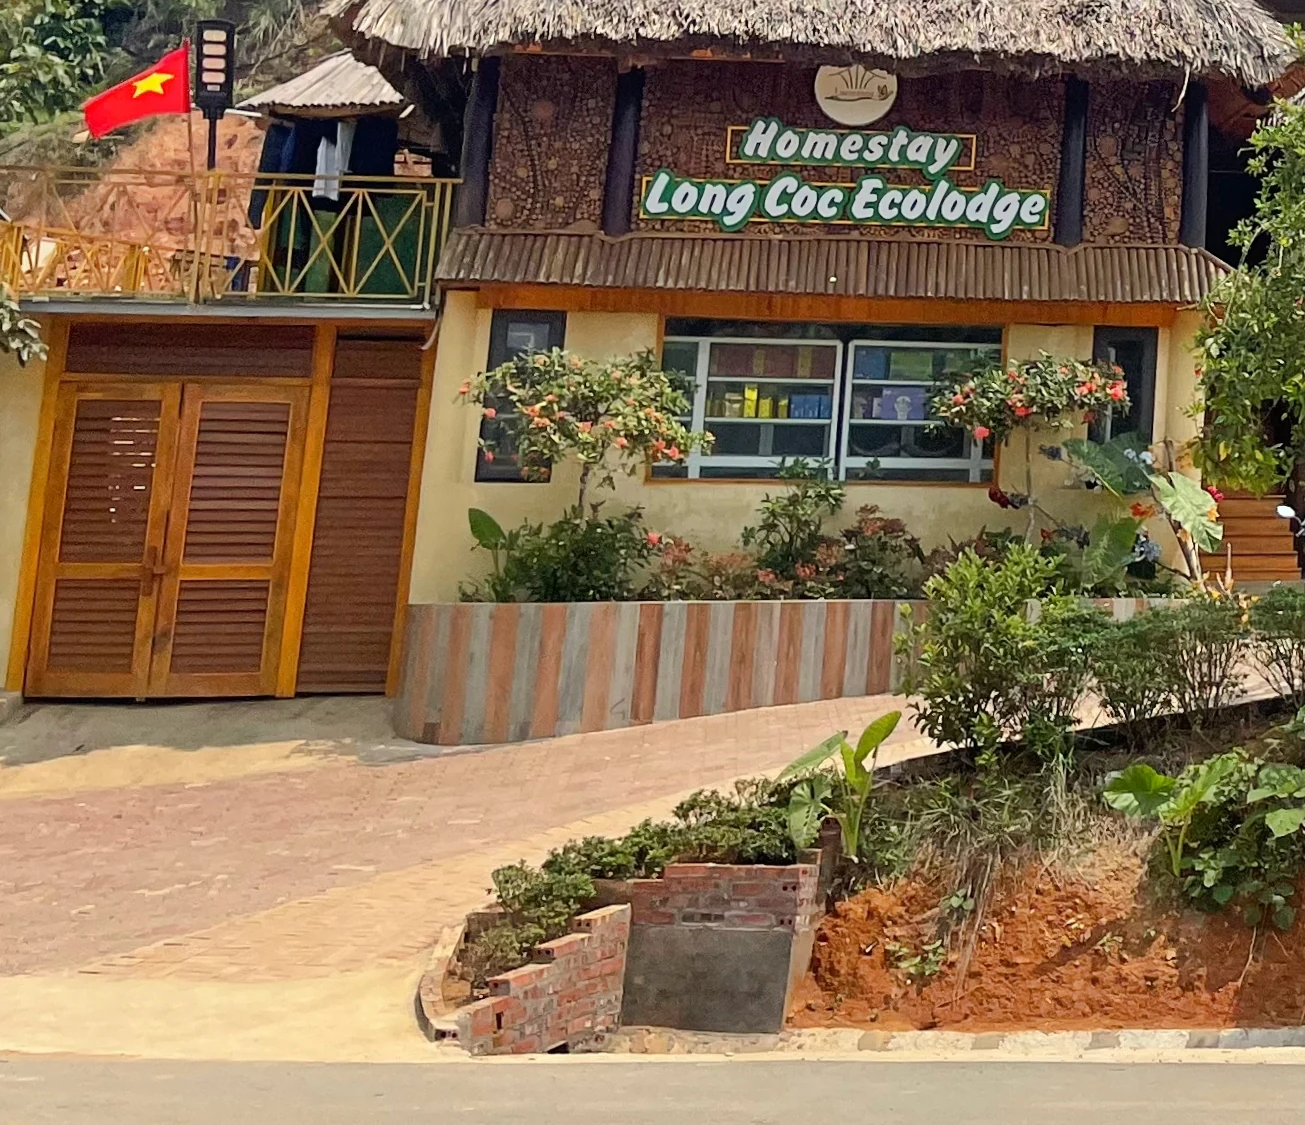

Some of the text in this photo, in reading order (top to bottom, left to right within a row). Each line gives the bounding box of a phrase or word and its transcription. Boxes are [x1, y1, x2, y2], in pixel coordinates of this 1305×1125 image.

[744, 119, 959, 173] Homestay
[645, 172, 1046, 234] Long Coc Ecolodge
